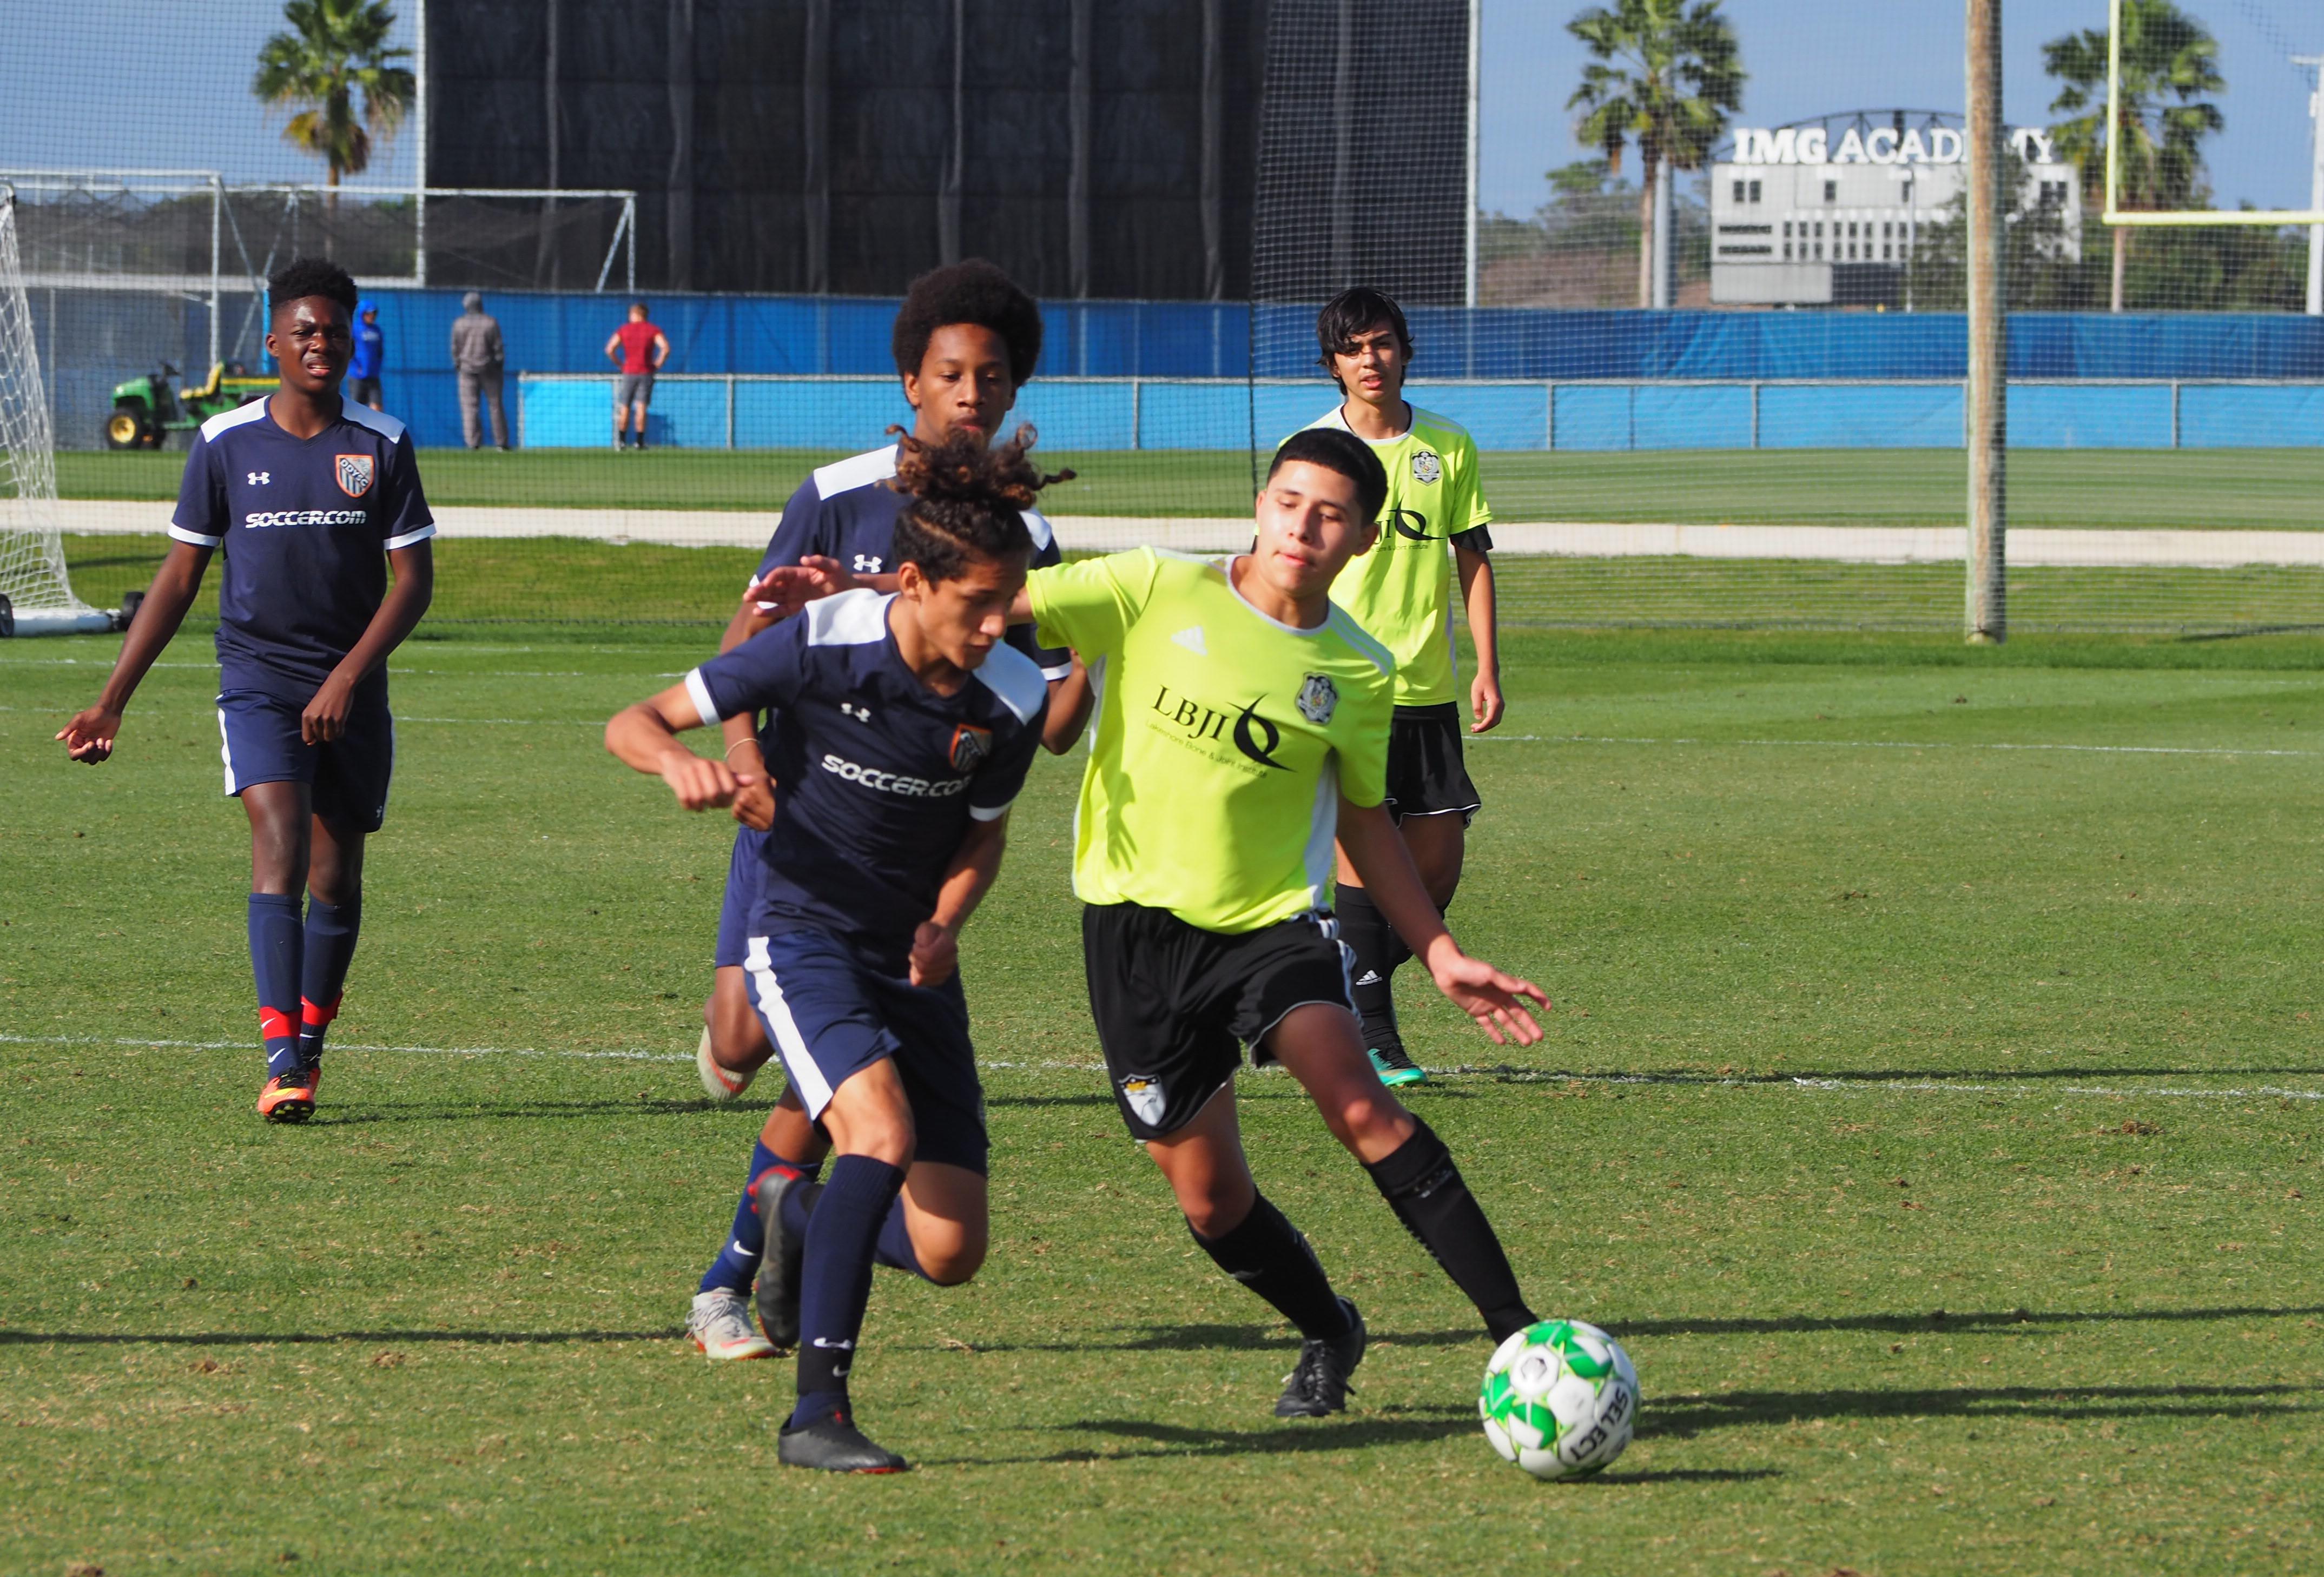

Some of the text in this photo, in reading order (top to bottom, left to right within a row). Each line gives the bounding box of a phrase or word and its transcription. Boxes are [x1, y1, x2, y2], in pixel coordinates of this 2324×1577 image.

[1733, 128, 2054, 164] IMG ACADMY
[1374, 519, 1392, 545] JI
[1152, 685, 1230, 741] LBJI
